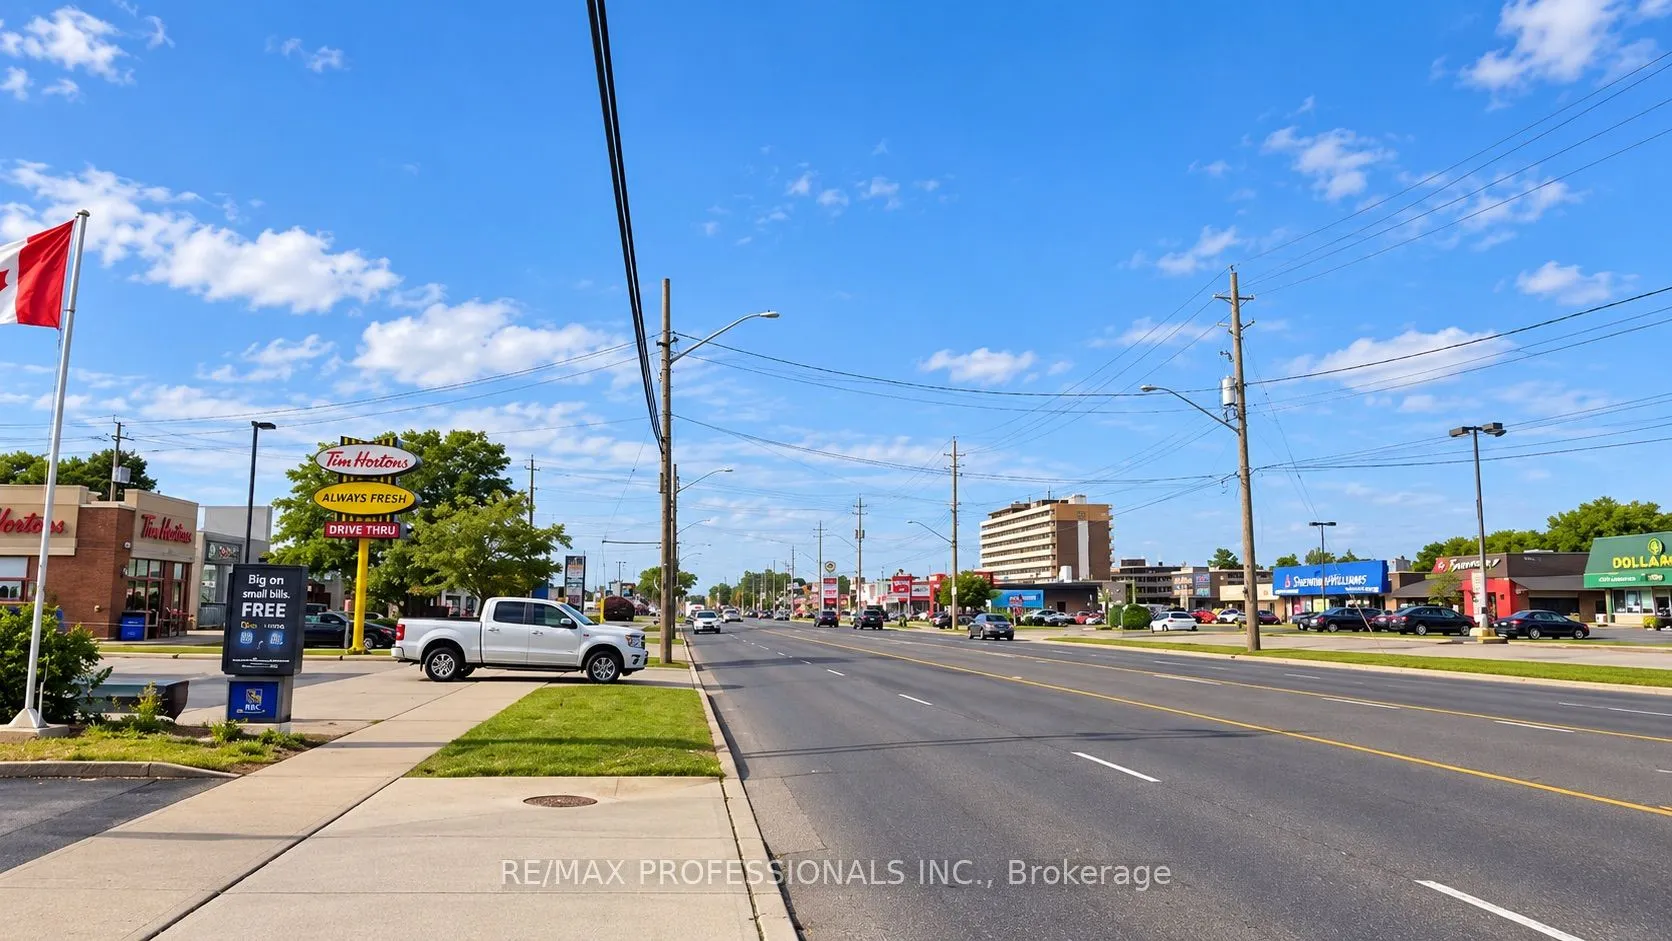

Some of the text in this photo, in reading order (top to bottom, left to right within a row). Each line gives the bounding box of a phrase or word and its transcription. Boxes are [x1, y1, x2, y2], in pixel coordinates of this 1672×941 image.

[326, 450, 408, 469] Tim Hortons
[322, 493, 407, 504] ALWAYS FRESH
[141, 513, 159, 539] Tim
[329, 525, 396, 535] DRIVE THRU
[248, 574, 284, 587] Big on
[242, 589, 291, 599] small bills.
[241, 602, 287, 618] FREE
[245, 703, 261, 711] RBC
